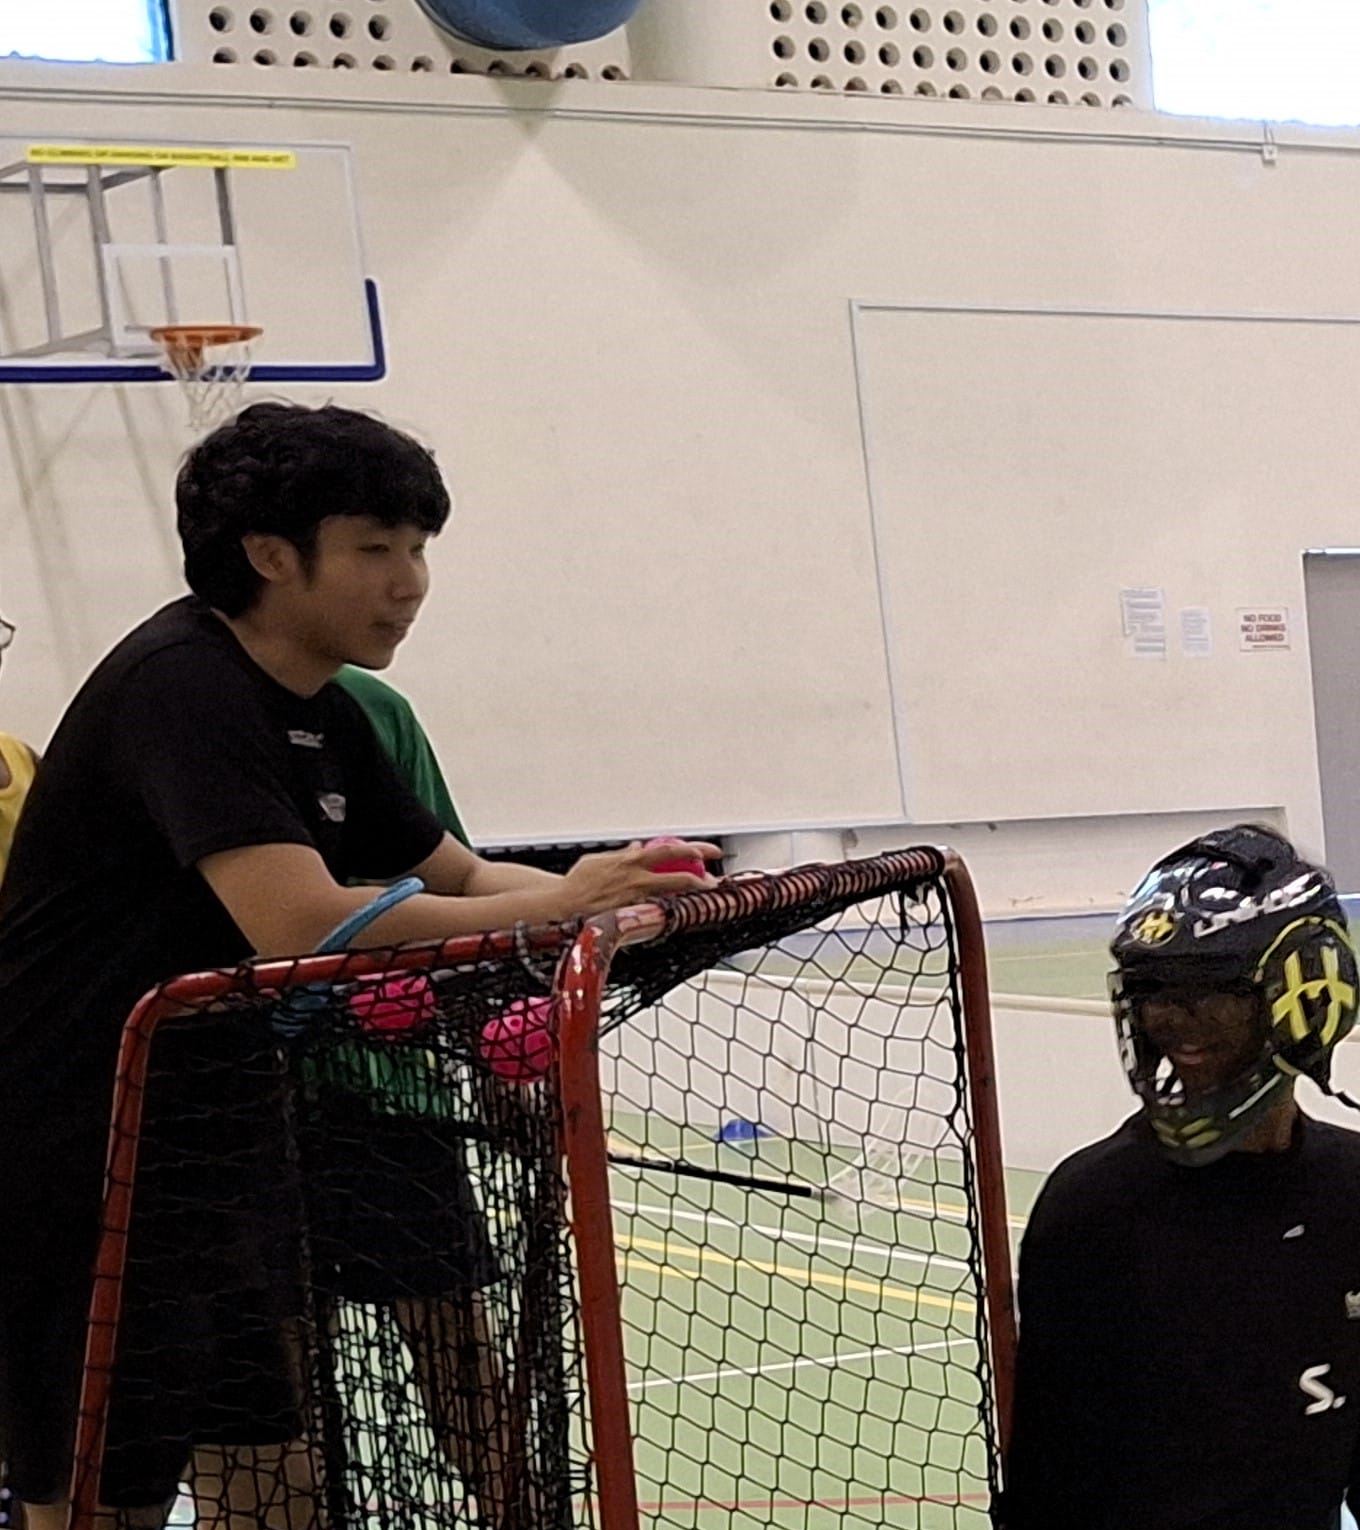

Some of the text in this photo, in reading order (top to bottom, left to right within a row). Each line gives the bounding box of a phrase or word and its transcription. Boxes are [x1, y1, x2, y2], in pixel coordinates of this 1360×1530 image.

[1243, 614, 1282, 622] NO FOOD
[1241, 624, 1254, 632] NO
[1245, 633, 1285, 642] ALLOWED
